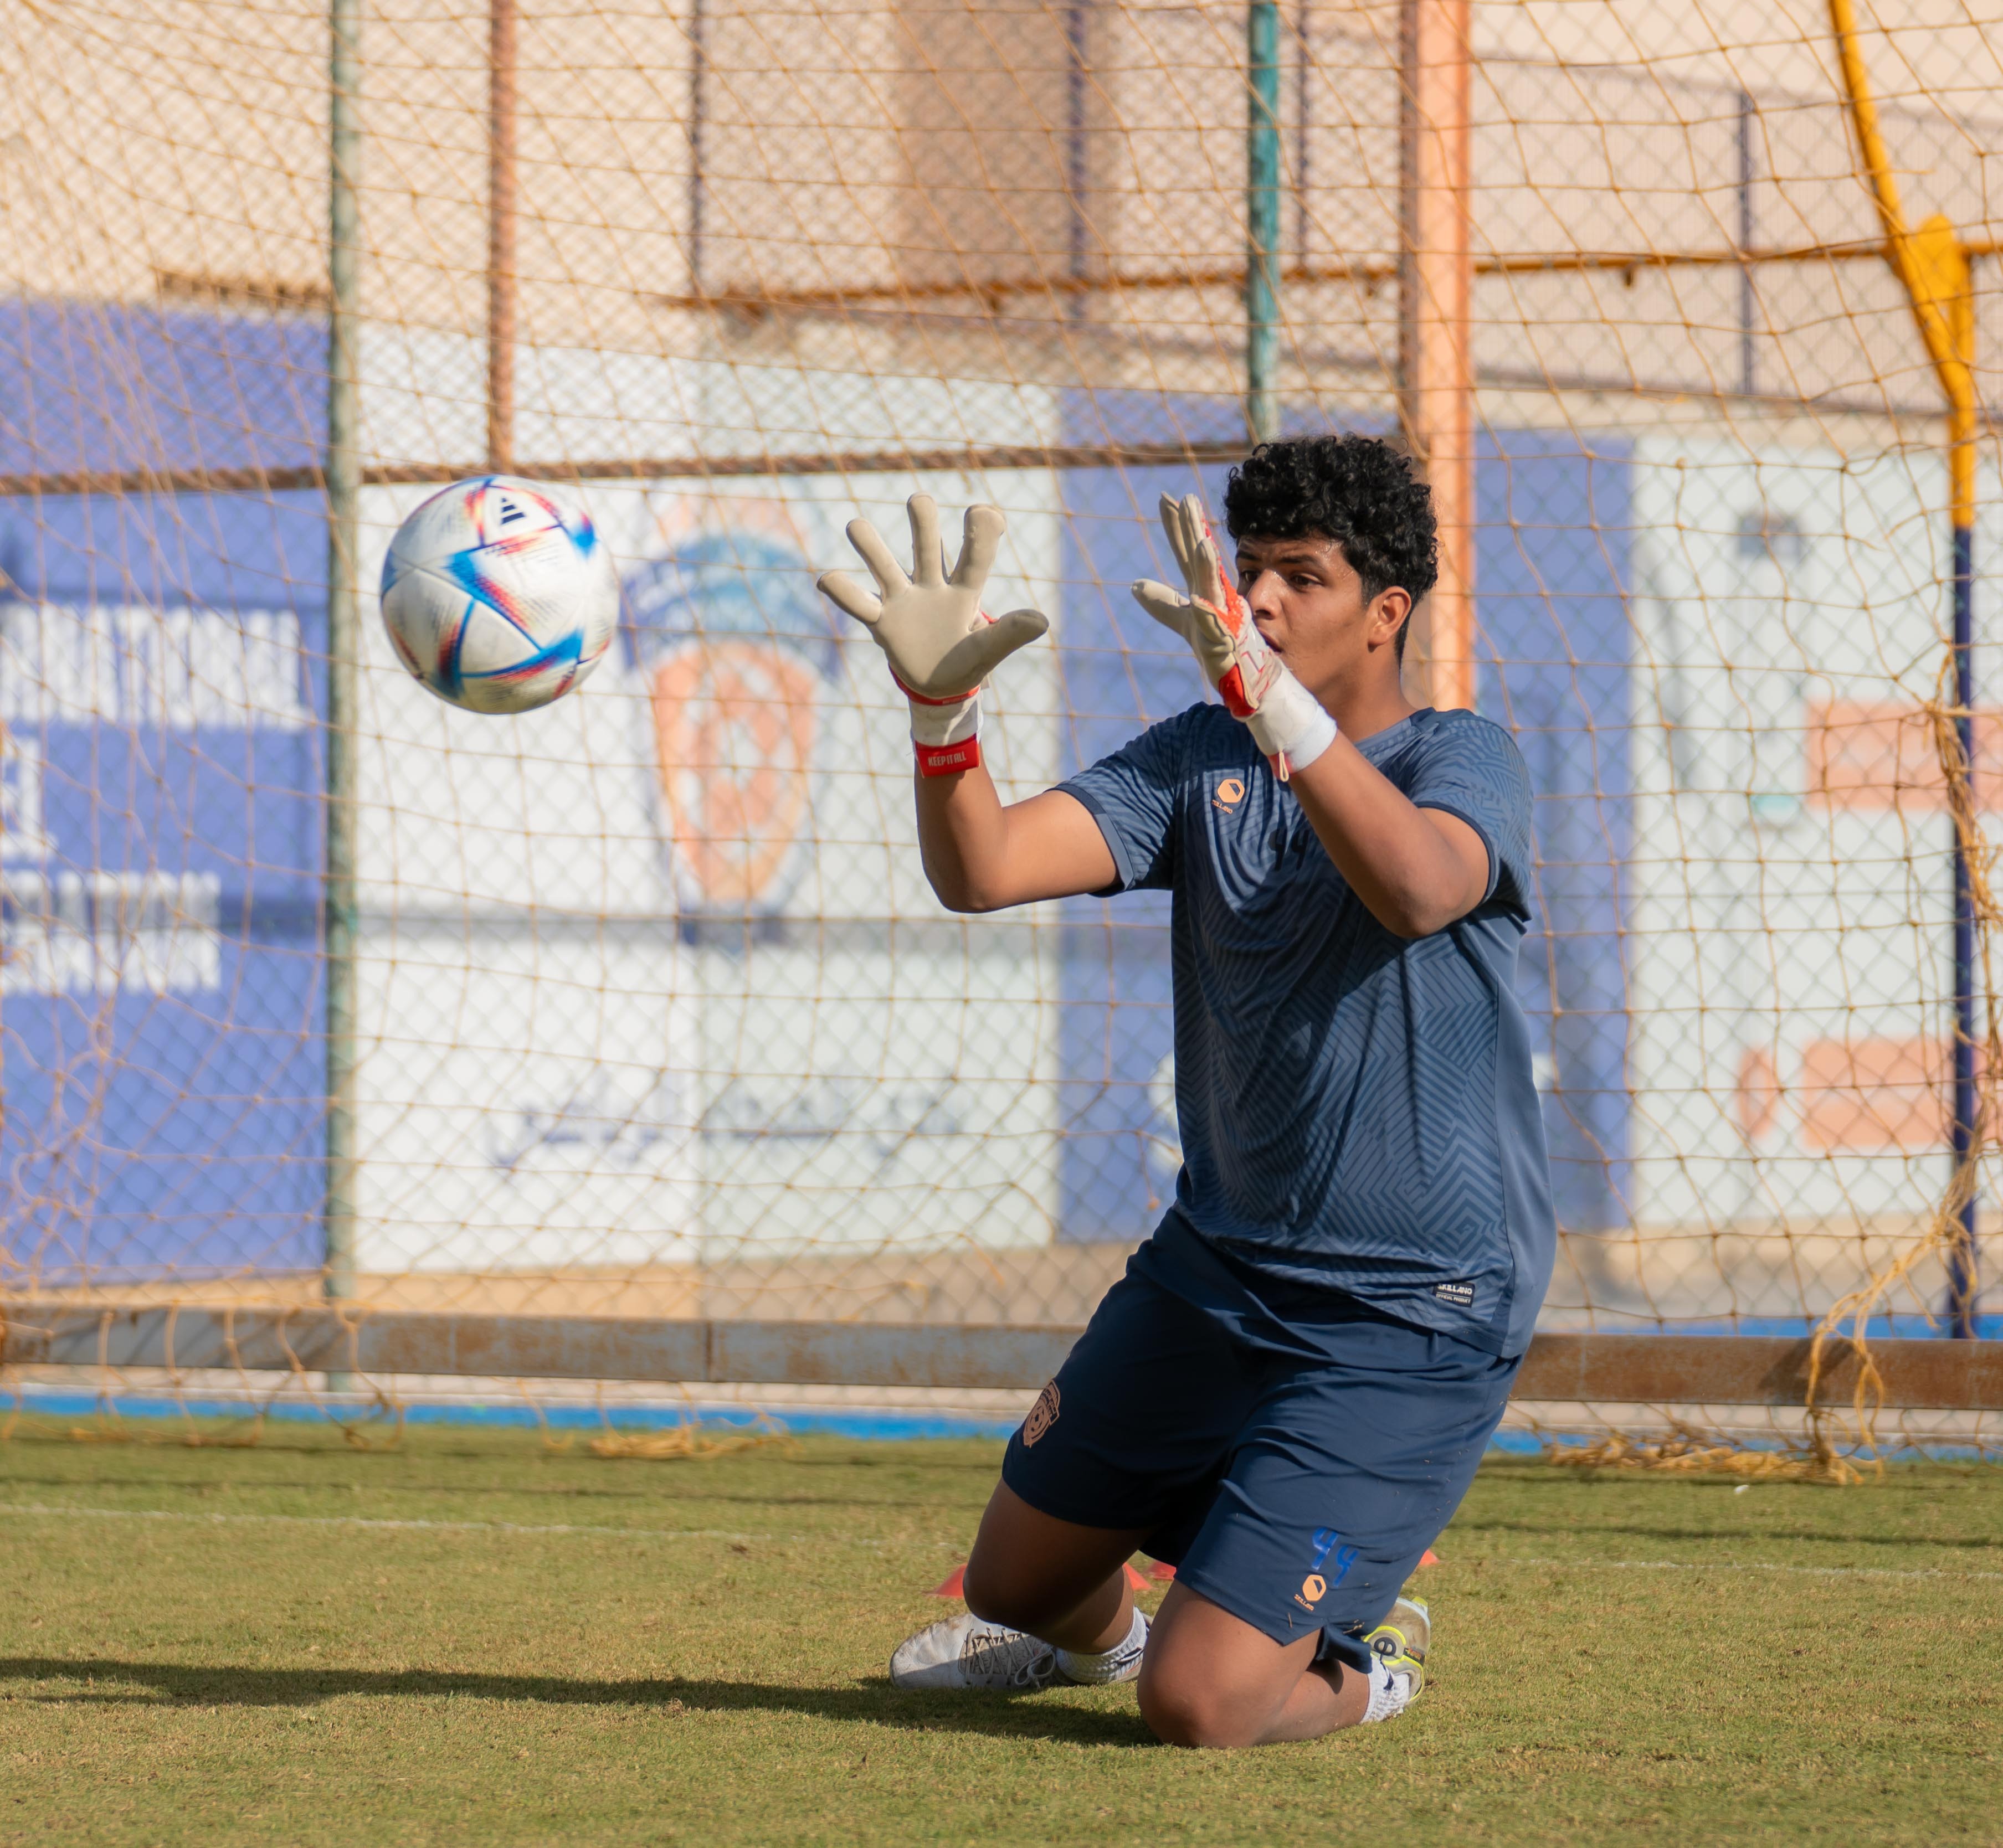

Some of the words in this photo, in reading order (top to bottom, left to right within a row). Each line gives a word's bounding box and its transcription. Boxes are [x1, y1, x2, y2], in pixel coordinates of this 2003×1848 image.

[928, 756, 946, 766] KEEP
[947, 755, 953, 765] IT
[954, 751, 966, 763] ALL
